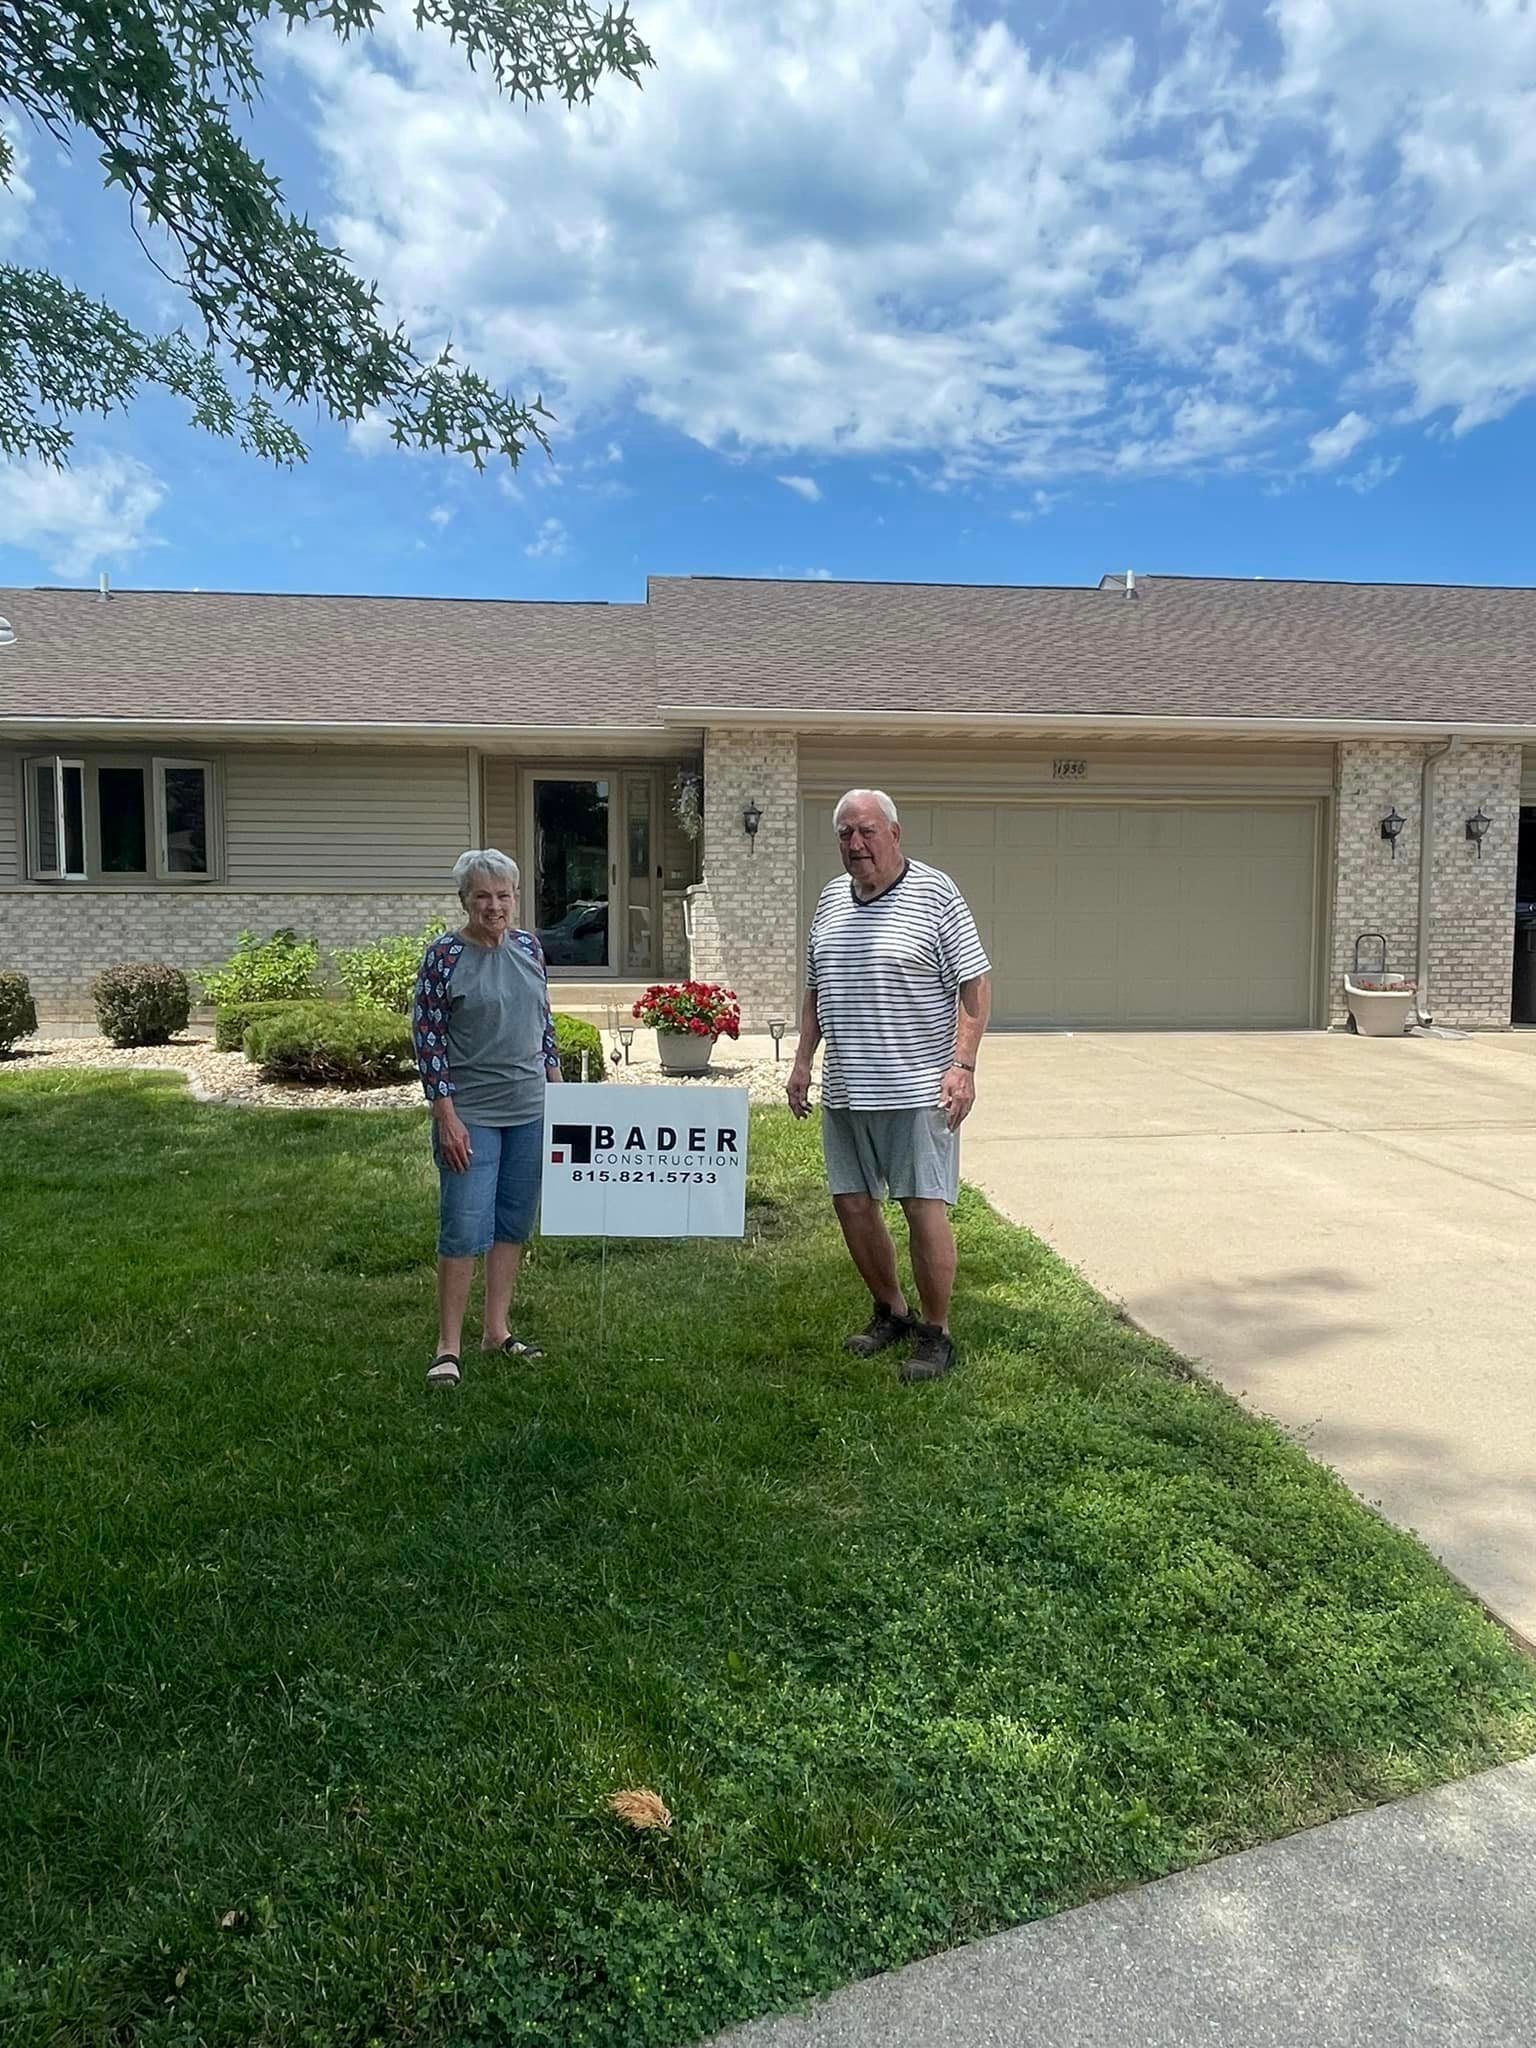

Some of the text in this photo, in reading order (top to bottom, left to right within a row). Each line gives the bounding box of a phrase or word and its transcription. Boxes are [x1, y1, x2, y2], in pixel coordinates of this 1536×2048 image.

[595, 1126, 738, 1152] BADER
[594, 1153, 739, 1166] CONSTRUCTION
[572, 1170, 717, 1183] 815.821.5733
